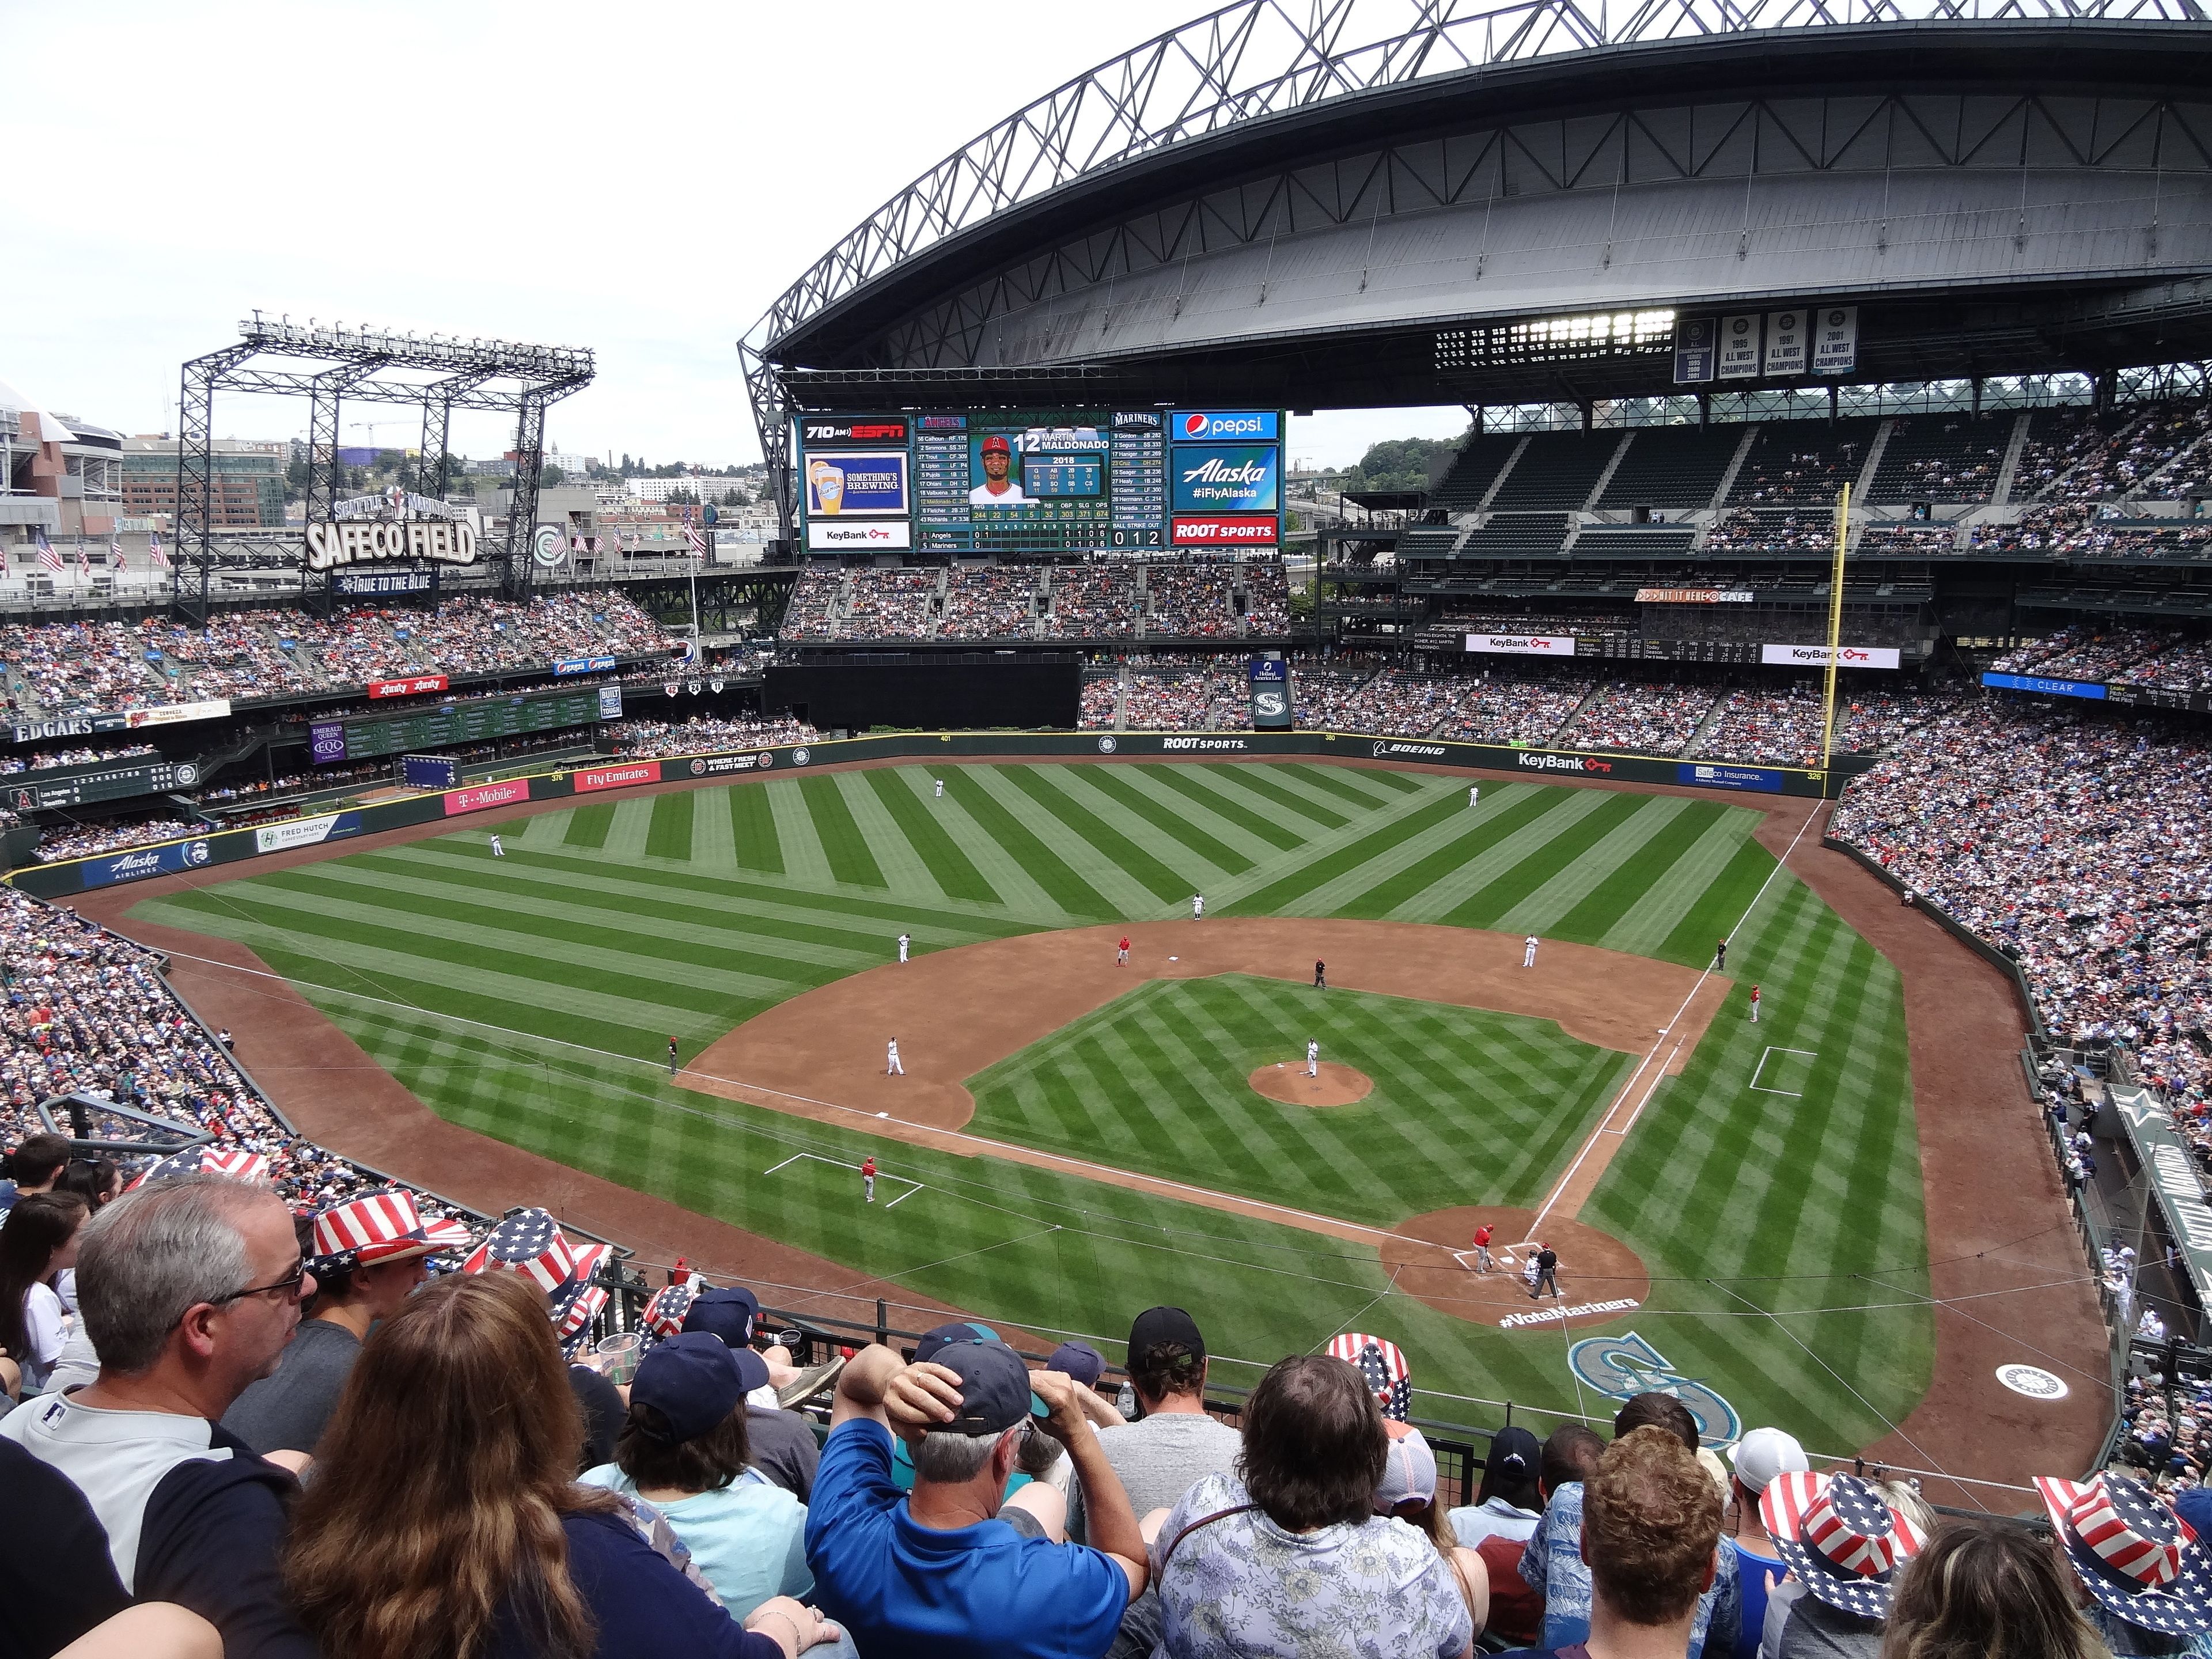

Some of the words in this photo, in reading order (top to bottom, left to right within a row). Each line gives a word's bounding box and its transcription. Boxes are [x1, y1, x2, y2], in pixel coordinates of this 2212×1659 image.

[1779, 335, 1794, 344] 1997
[1783, 347, 1800, 357] WEST
[1833, 343, 1850, 353] WEST
[1737, 351, 1753, 361] WEST
[1767, 360, 1803, 371] CHAMPIONS
[1816, 356, 1853, 368] CHAMPIONS
[1721, 363, 1756, 374] CHAMPIONS
[925, 416, 959, 428] ANGELS
[1115, 413, 1157, 426] MARINERS
[1213, 416, 1260, 435] pepsi
[806, 426, 834, 438] 710
[851, 425, 903, 438] ESPN
[1013, 434, 1040, 452] 12
[1042, 441, 1109, 449] MALDONADO
[847, 473, 897, 482] SOMETHING'S
[1183, 459, 1266, 485] Alaska
[847, 482, 899, 490] BREWING
[1192, 487, 1256, 500] #iFlyAlaska
[334, 495, 382, 518] SEATTLE
[407, 492, 453, 518] MARINERS
[827, 531, 867, 540] KeyBank
[1176, 524, 1219, 537] ROOT
[1220, 527, 1272, 537] SPORTS
[1115, 532, 1123, 544] 0
[1134, 531, 1139, 544] 1
[1149, 531, 1158, 544] 2
[306, 521, 403, 569] SAFECO
[407, 521, 475, 564] FIELD
[354, 575, 376, 592] TRUE
[378, 577, 389, 591] TO
[391, 577, 407, 590] THE
[409, 573, 430, 589] BLUE
[1659, 591, 1672, 601] HIT
[1675, 591, 1683, 601] IT
[1685, 591, 1705, 601] HERE
[1719, 592, 1753, 601] CAFE
[1490, 638, 1528, 649] KeyBank
[567, 664, 584, 673] pepsi
[597, 660, 615, 669] pepsi
[380, 683, 407, 695] xfinity
[414, 680, 440, 691] xfinity
[2037, 681, 2073, 692] CLEAR
[601, 690, 619, 699] BUILT
[603, 707, 620, 715] TOUGH
[313, 726, 342, 734] EMERALD
[318, 732, 338, 740] QUEEN
[1164, 738, 1200, 749] ROOT
[1200, 740, 1244, 749] SPORTS
[1390, 744, 1446, 755] BOEING
[1518, 753, 1584, 770] KeyBank
[587, 774, 604, 786] Fly
[606, 769, 649, 782] Emirates
[1698, 768, 1721, 777] Safeco
[1725, 771, 1759, 780] Insurance
[281, 828, 301, 836] FRED
[304, 823, 328, 832] HUTCH
[111, 852, 159, 872] Alaska
[115, 866, 157, 879] AIRLINES
[1499, 1297, 1639, 1328] #VoteMariners
